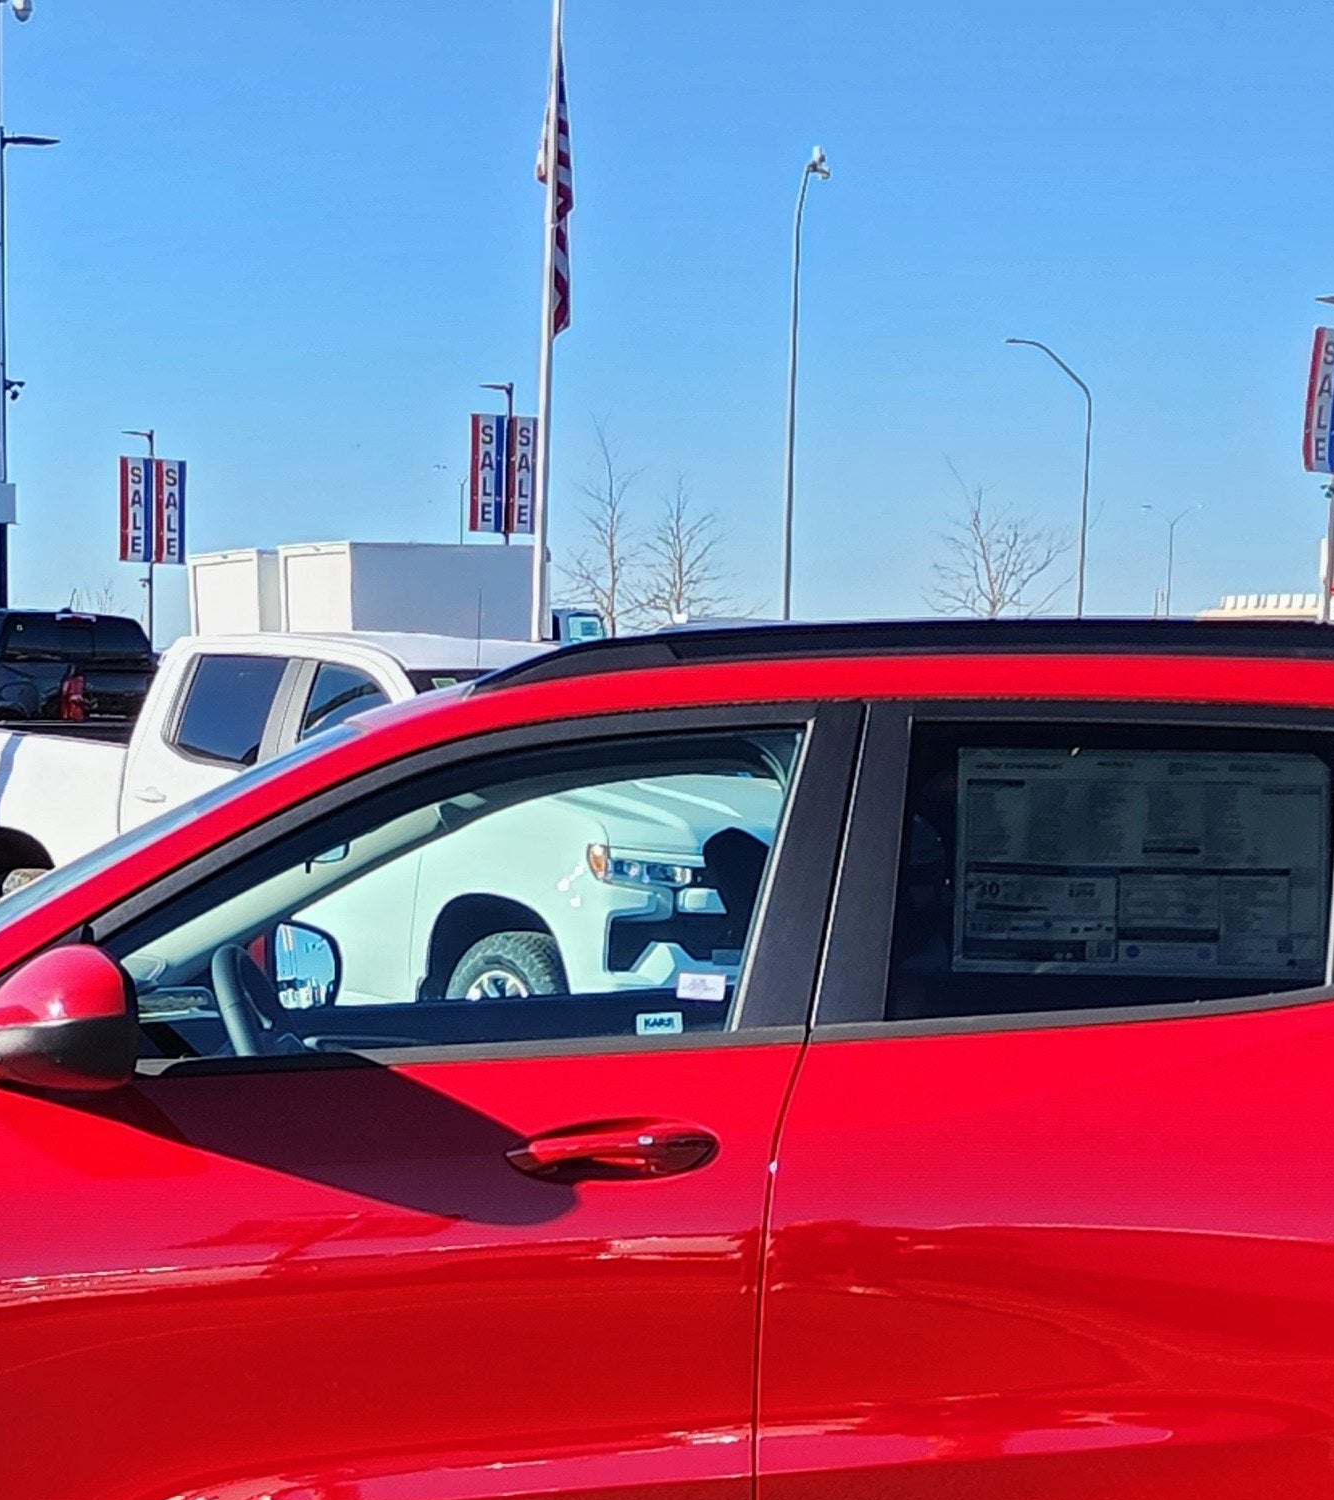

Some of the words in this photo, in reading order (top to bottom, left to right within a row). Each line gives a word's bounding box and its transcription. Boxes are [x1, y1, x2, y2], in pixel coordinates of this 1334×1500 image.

[130, 466, 142, 553] SALE
[165, 468, 178, 556] SALE
[480, 425, 494, 522] SALE
[517, 427, 531, 524] SALE
